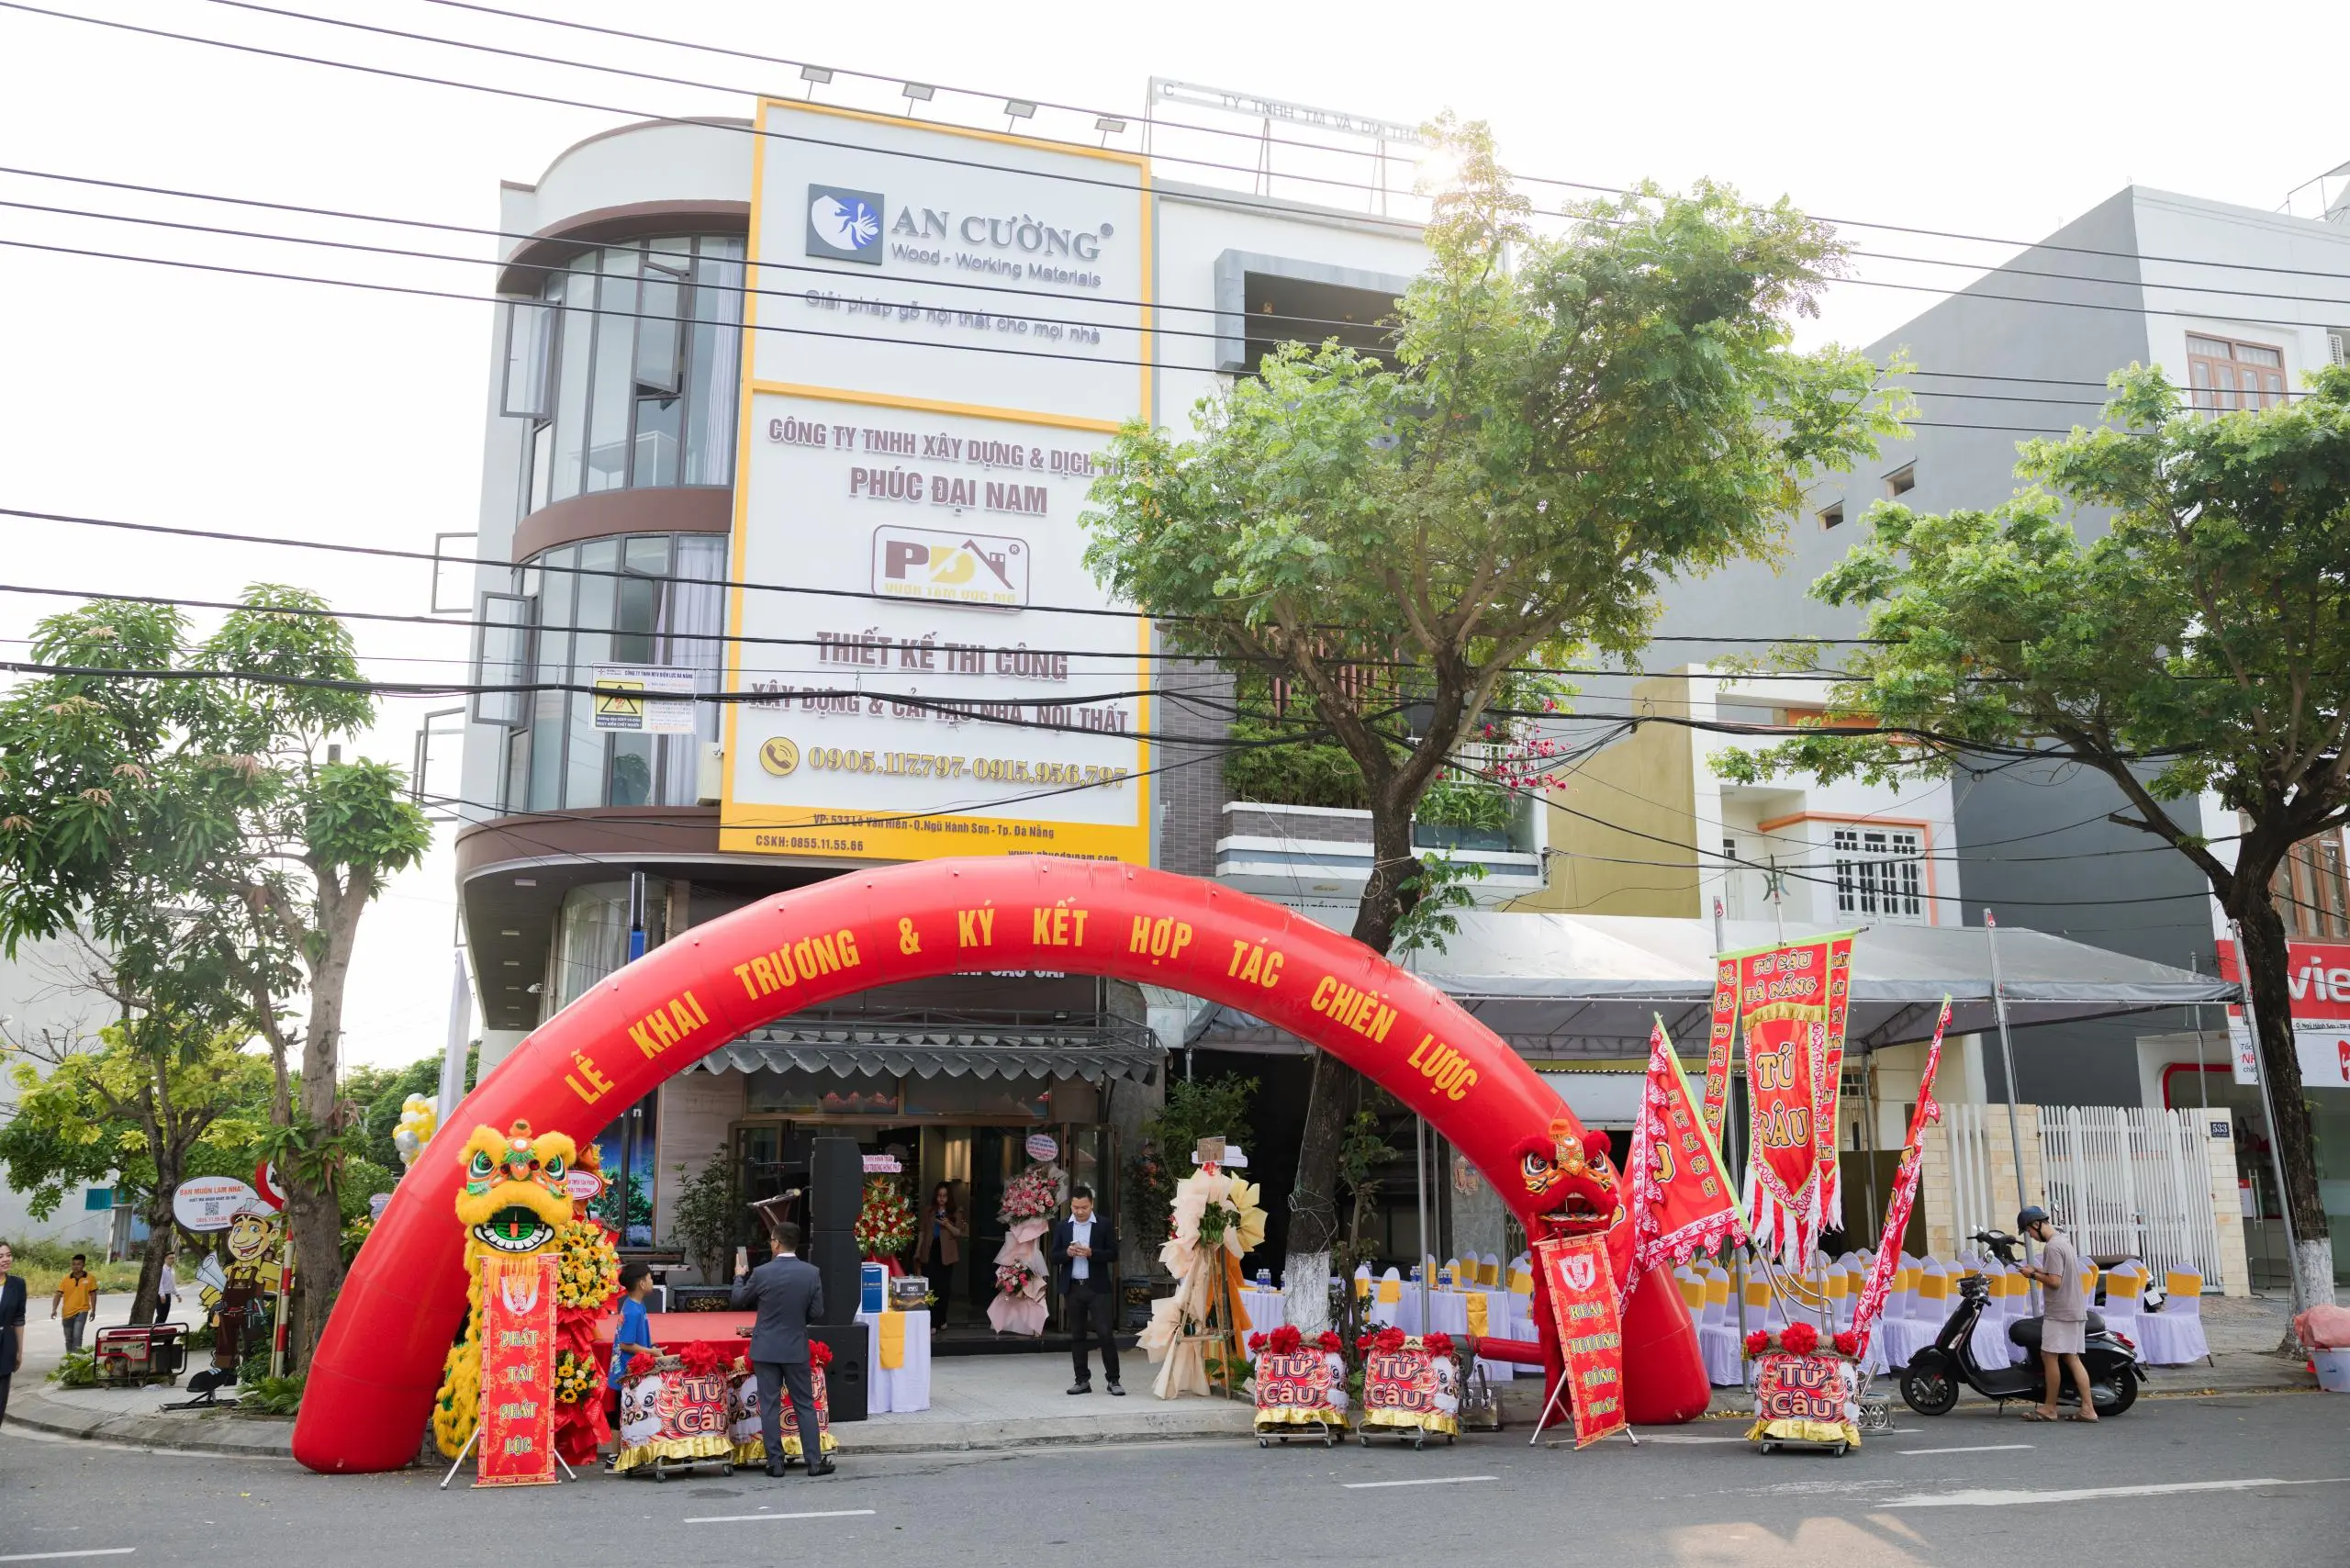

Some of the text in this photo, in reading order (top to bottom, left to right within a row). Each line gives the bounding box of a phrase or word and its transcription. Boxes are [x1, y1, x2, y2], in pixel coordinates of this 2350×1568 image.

[890, 206, 1102, 261] AN CƯỜNG
[891, 242, 940, 265] Wood
[956, 252, 1022, 277] Working
[1028, 263, 1102, 287] Materials
[806, 290, 841, 310] Giải
[848, 296, 892, 317] pháp
[997, 317, 1028, 333] cho
[1034, 322, 1063, 342] mọi
[1070, 327, 1101, 345] nhà
[768, 416, 826, 447] CÔNG
[833, 426, 857, 450] TY
[863, 429, 916, 455] TNHH
[923, 432, 963, 460] XÂY
[968, 440, 1024, 469] DỰNG
[1030, 448, 1045, 469] &
[1050, 450, 1095, 476] DỊCH
[850, 465, 1047, 515] PHÚC ĐẠI NAM
[816, 626, 1069, 682] THIẾT KẾ THI CÔNG
[750, 678, 795, 711] XÂY
[801, 686, 860, 718] DỰNG
[868, 698, 884, 717] &
[1079, 701, 1128, 734] THẤT
[945, 821, 968, 834] Hành
[971, 822, 990, 834] Sơn
[997, 824, 1012, 837] Tp.
[565, 896, 1479, 1105] LỄ KHAI TRƯƠNG & KÝ KẾT HỢP TÁC CHIẾN LƯỢC
[2212, 1123, 2228, 1133] 533
[1570, 1300, 1604, 1319] KHAI
[501, 1327, 537, 1347] PHÁT
[1272, 1352, 1315, 1378] Tứ
[1379, 1355, 1420, 1380] Tứ
[1778, 1362, 1828, 1388] Tứ
[683, 1374, 722, 1403] Tứ
[1263, 1379, 1315, 1406] Câu
[1371, 1382, 1422, 1408] Câu
[500, 1399, 538, 1419] PHÁT
[1770, 1390, 1832, 1418] Câu
[505, 1436, 532, 1456] LỘC
